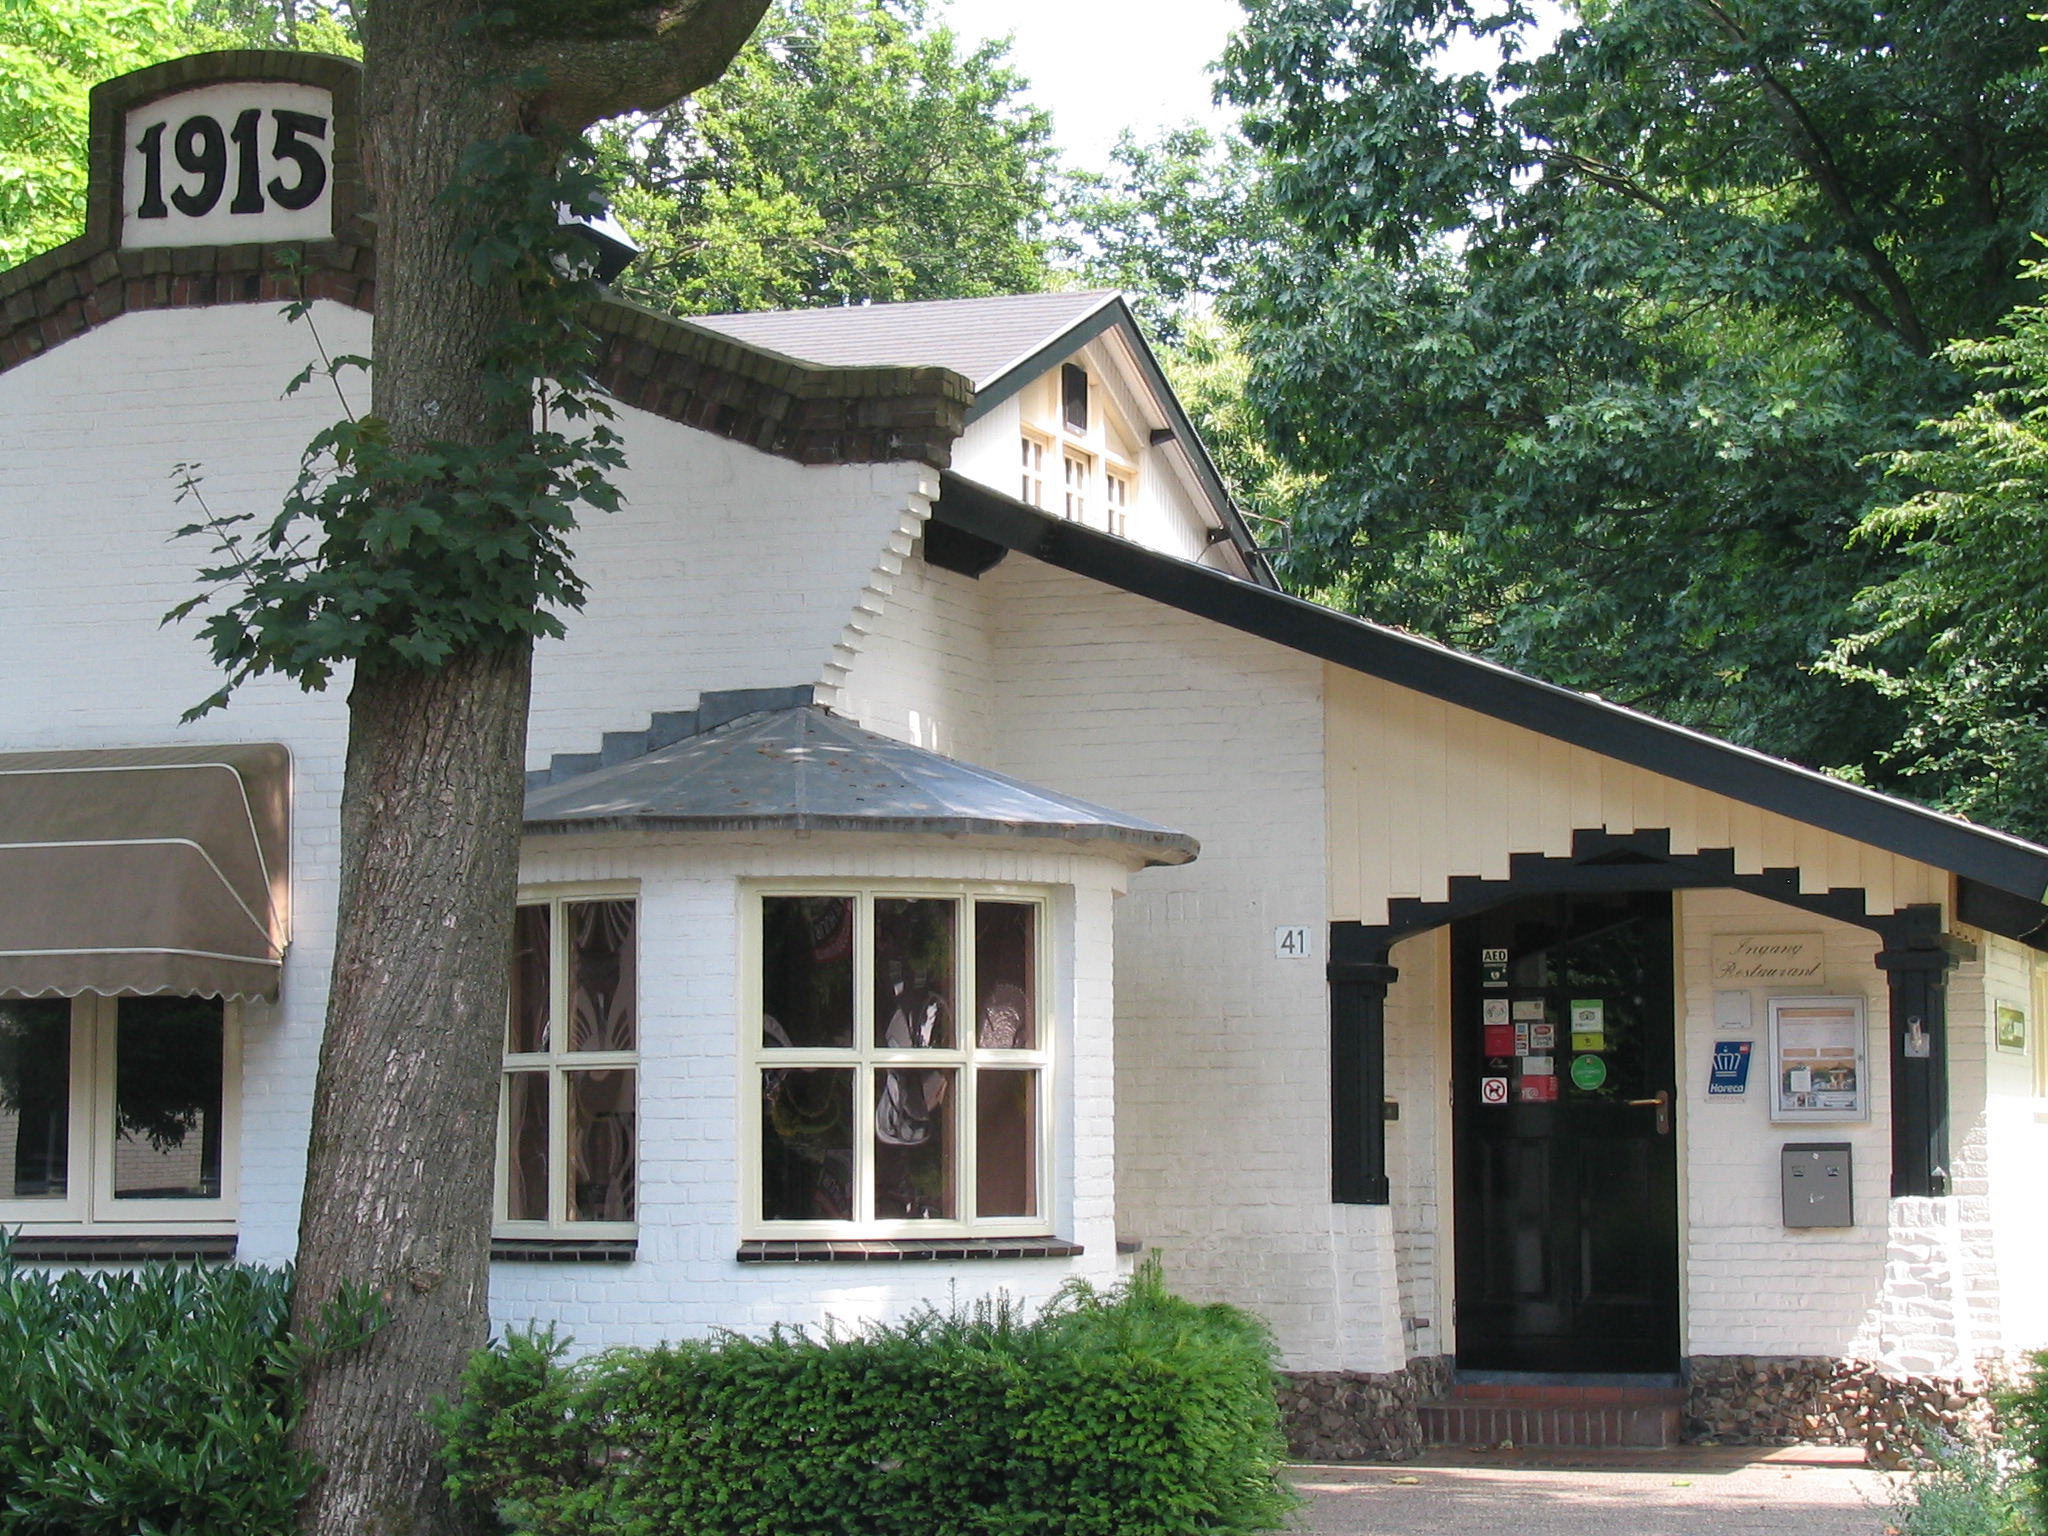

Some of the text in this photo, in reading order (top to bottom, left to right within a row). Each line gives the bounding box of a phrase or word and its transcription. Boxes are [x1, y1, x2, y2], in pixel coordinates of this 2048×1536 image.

[136, 108, 328, 219] 1915
[1280, 929, 1304, 954] 41
[1729, 938, 1803, 959] Ingang
[1484, 950, 1506, 961] AED
[1716, 962, 1821, 979] Restaurant
[1710, 1083, 1744, 1093] Horeca
